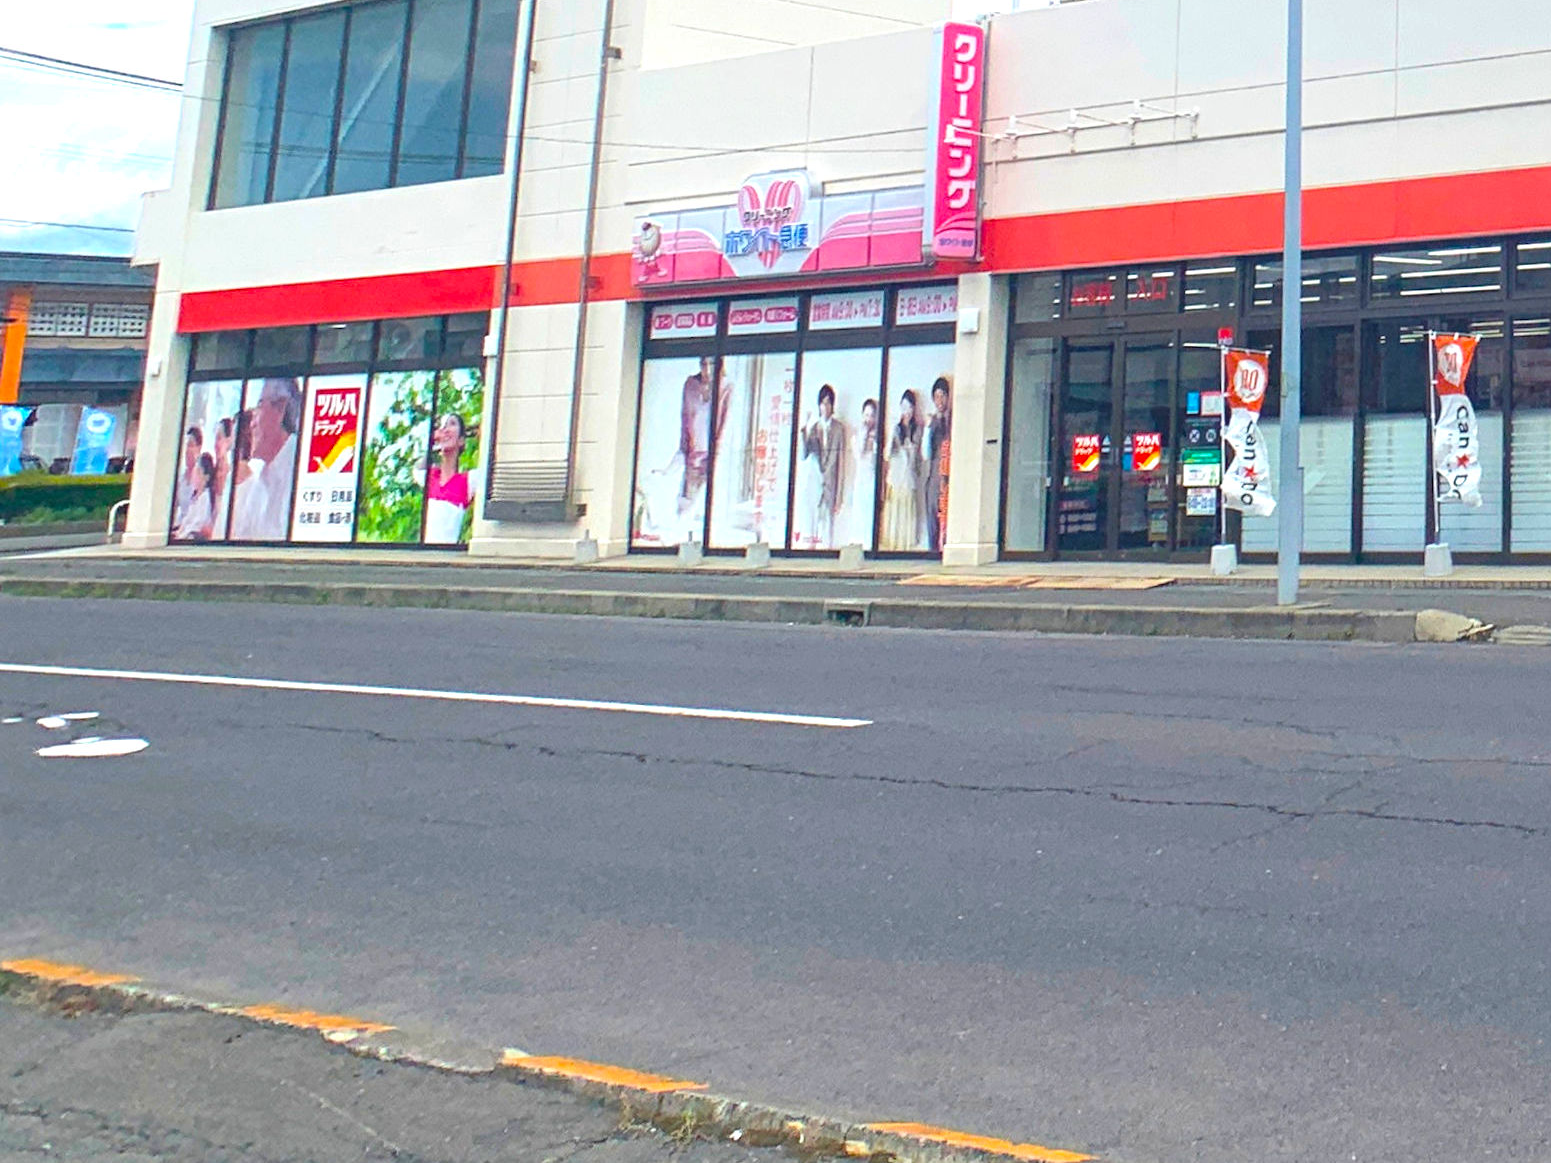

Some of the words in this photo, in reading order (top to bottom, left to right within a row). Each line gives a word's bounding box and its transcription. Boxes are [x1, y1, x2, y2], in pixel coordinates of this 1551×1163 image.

[945, 34, 976, 209] クリーニング
[317, 393, 357, 417] ツルハ
[1456, 405, 1470, 449] Can
